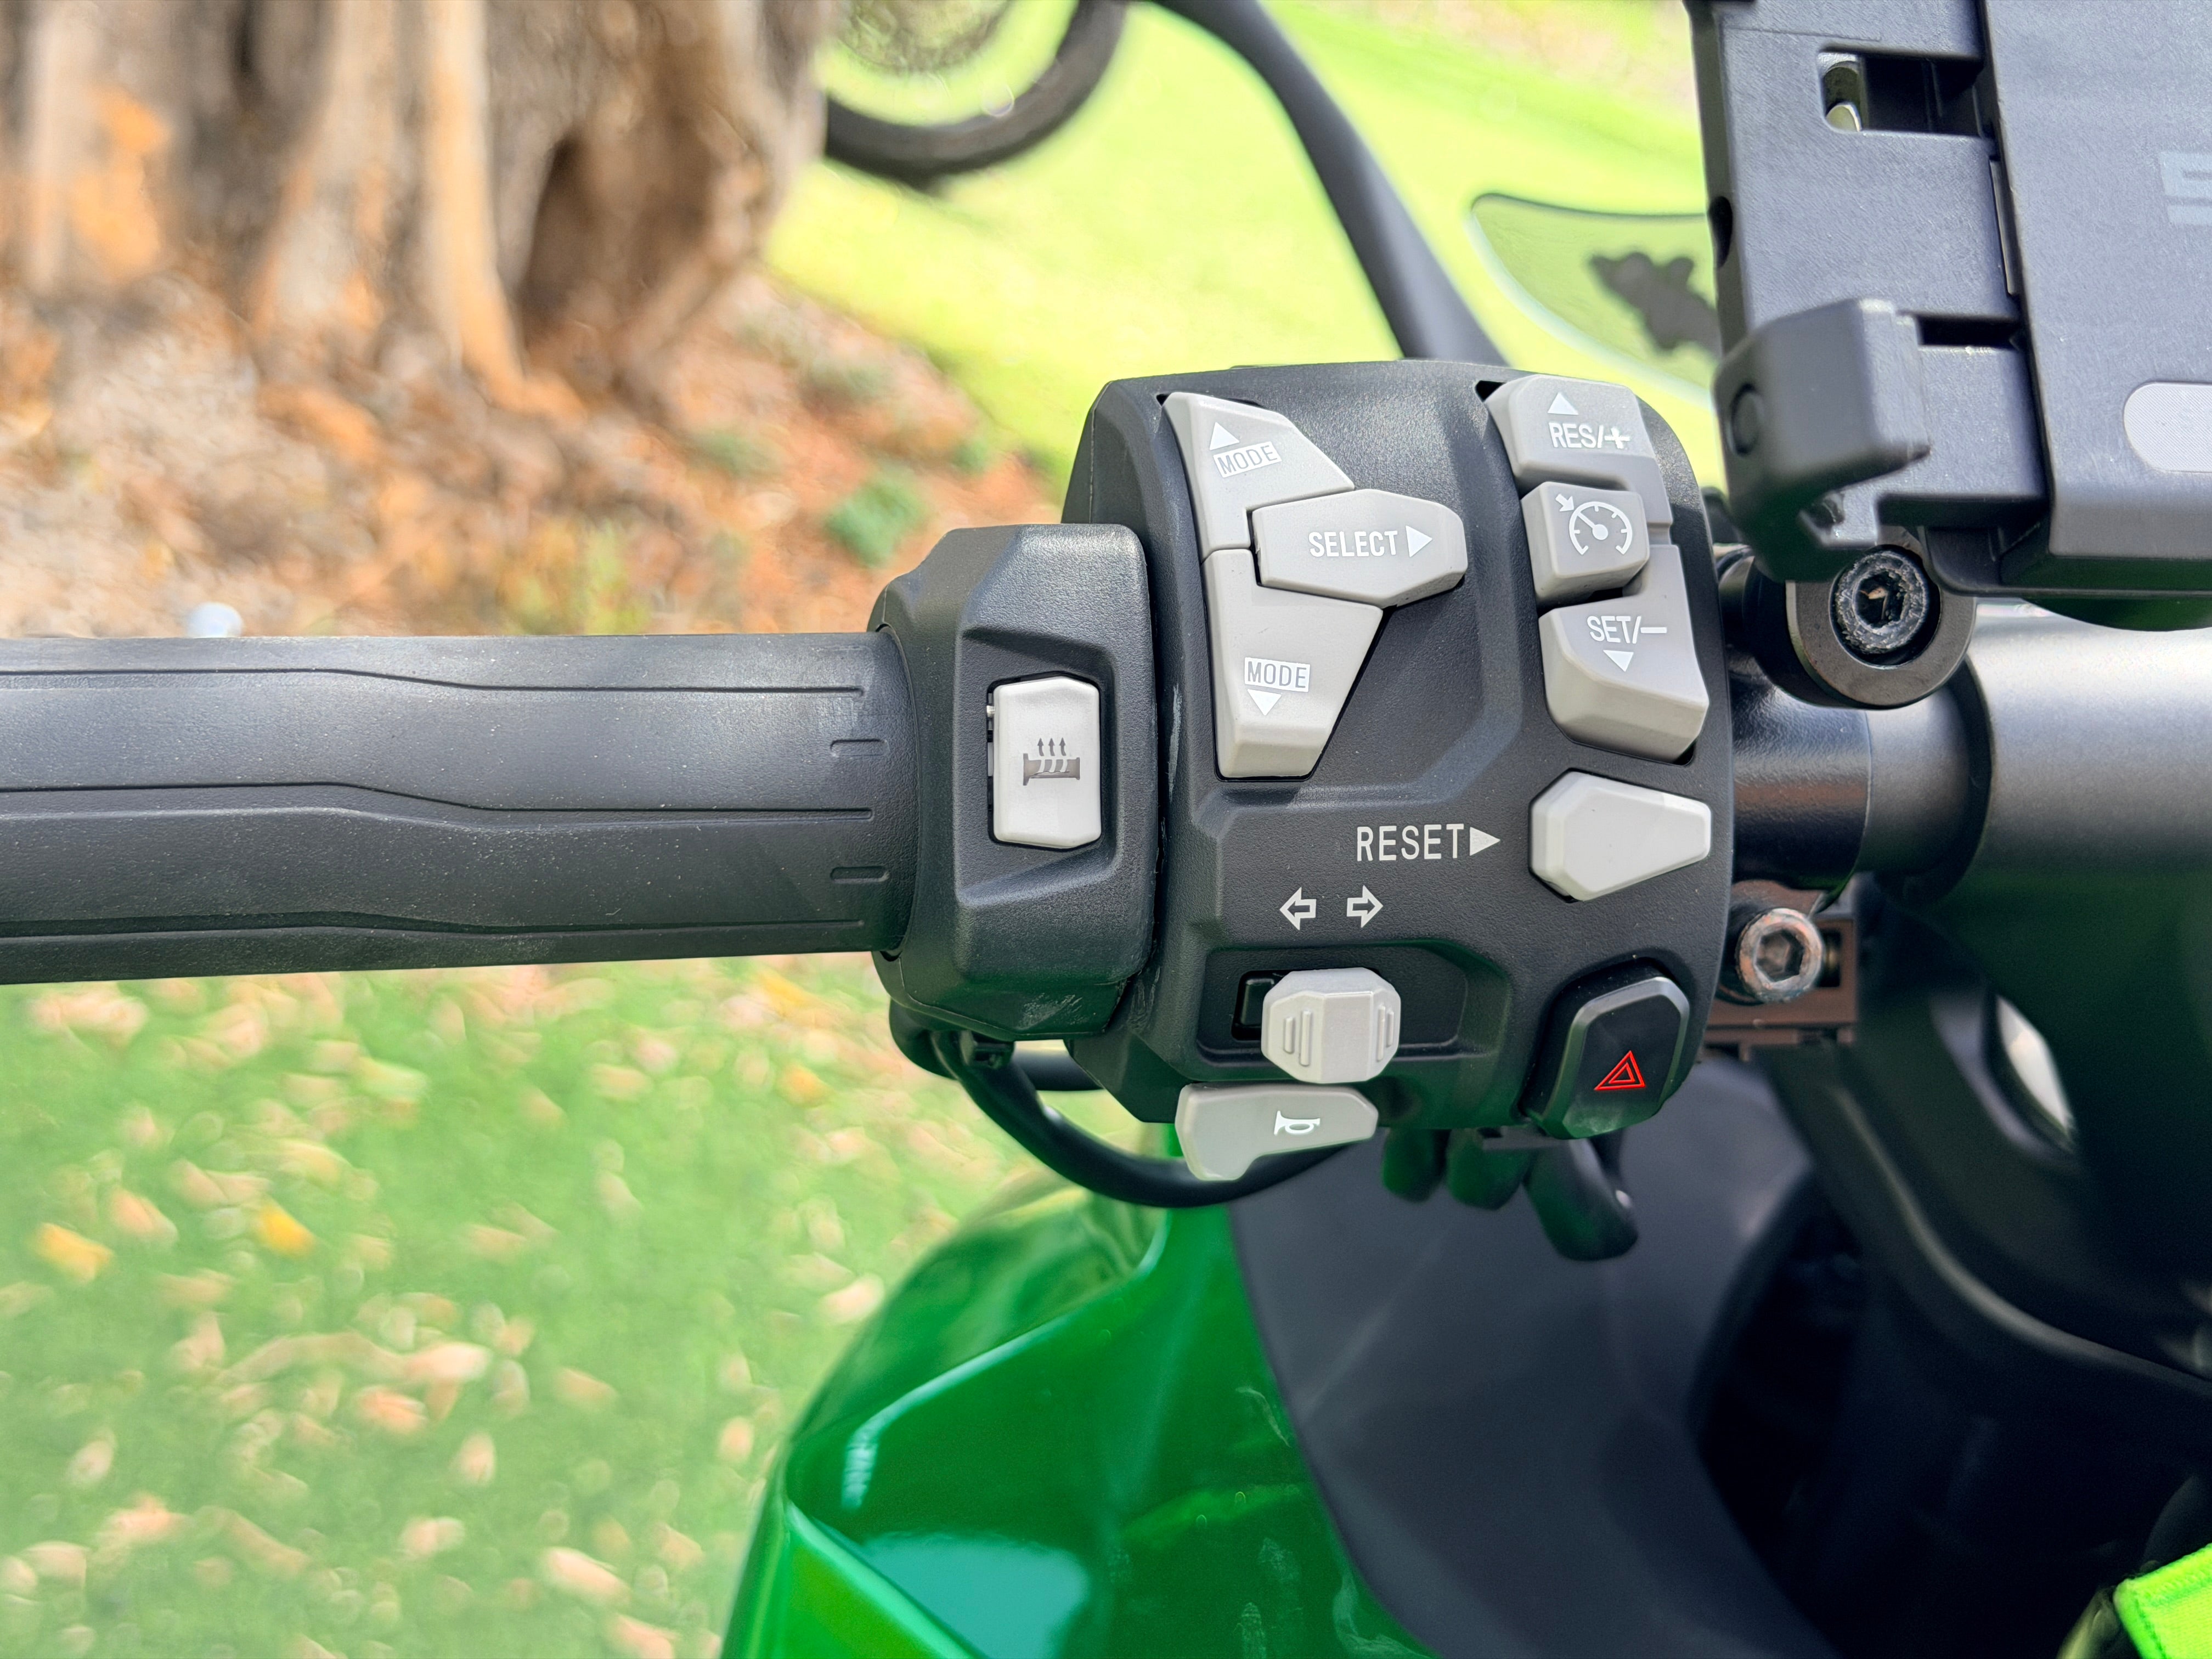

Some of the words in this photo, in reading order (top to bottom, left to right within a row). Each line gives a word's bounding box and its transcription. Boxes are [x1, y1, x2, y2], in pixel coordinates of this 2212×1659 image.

[1548, 422, 1631, 449] RES/+
[1217, 444, 1278, 475] MODE
[1308, 531, 1398, 557] SELECT
[1247, 661, 1307, 689] MODE
[1357, 823, 1464, 862] RESET
